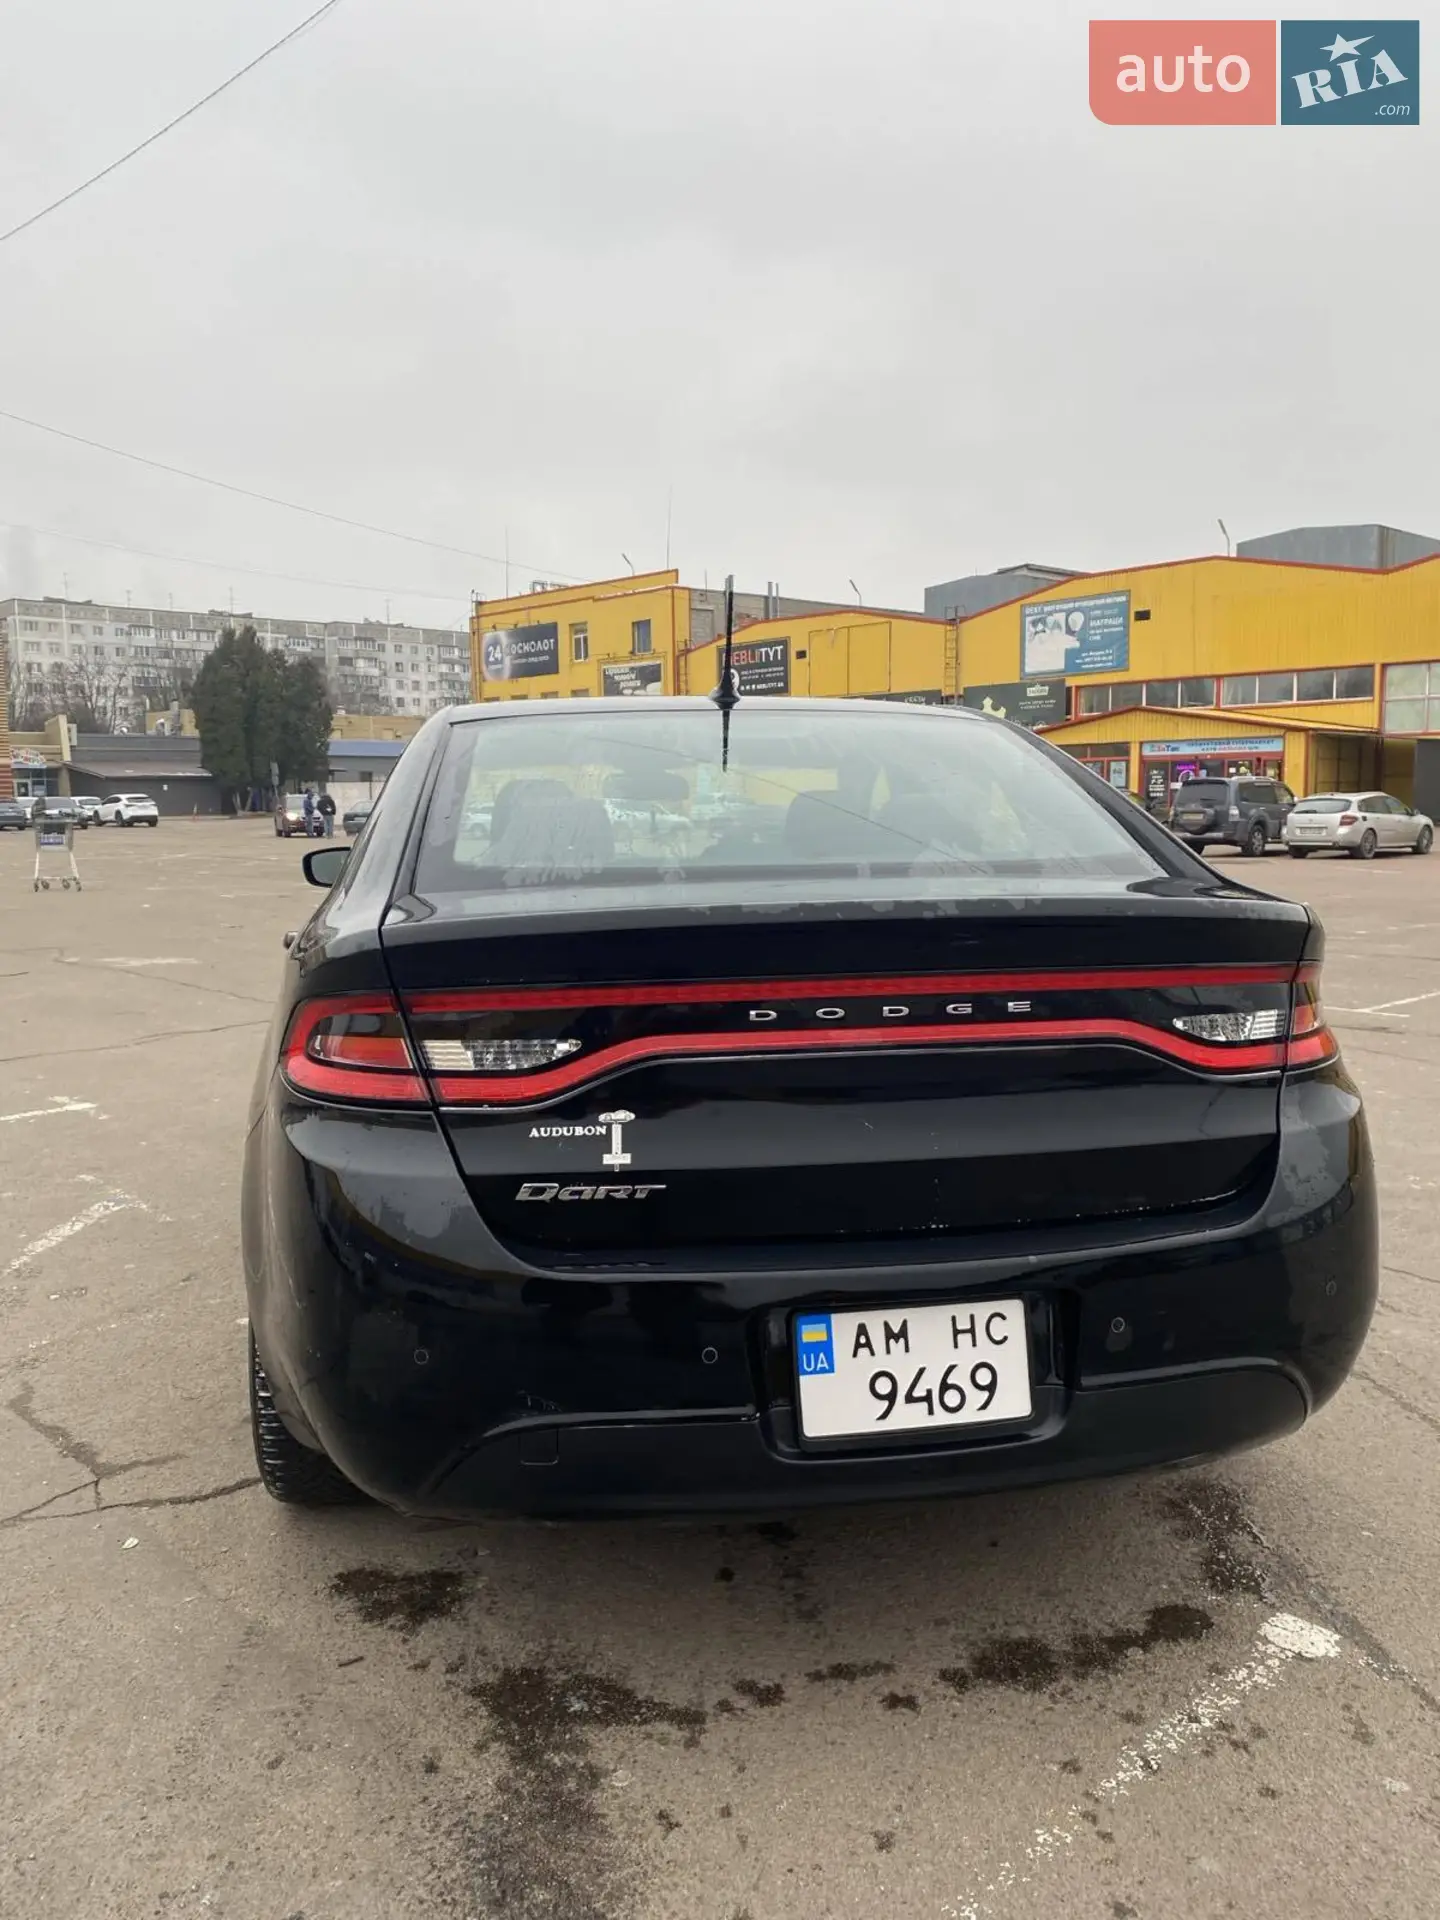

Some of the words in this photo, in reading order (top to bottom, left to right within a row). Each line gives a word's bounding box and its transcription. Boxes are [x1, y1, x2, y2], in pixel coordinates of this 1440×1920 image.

[487, 644, 503, 662] 24
[749, 1000, 1031, 1021] DODGE
[529, 1125, 607, 1138] AUDUBON
[852, 1318, 910, 1359] AM
[951, 1311, 1009, 1349] HC
[802, 1352, 829, 1372] UA
[868, 1361, 998, 1421] 9469
